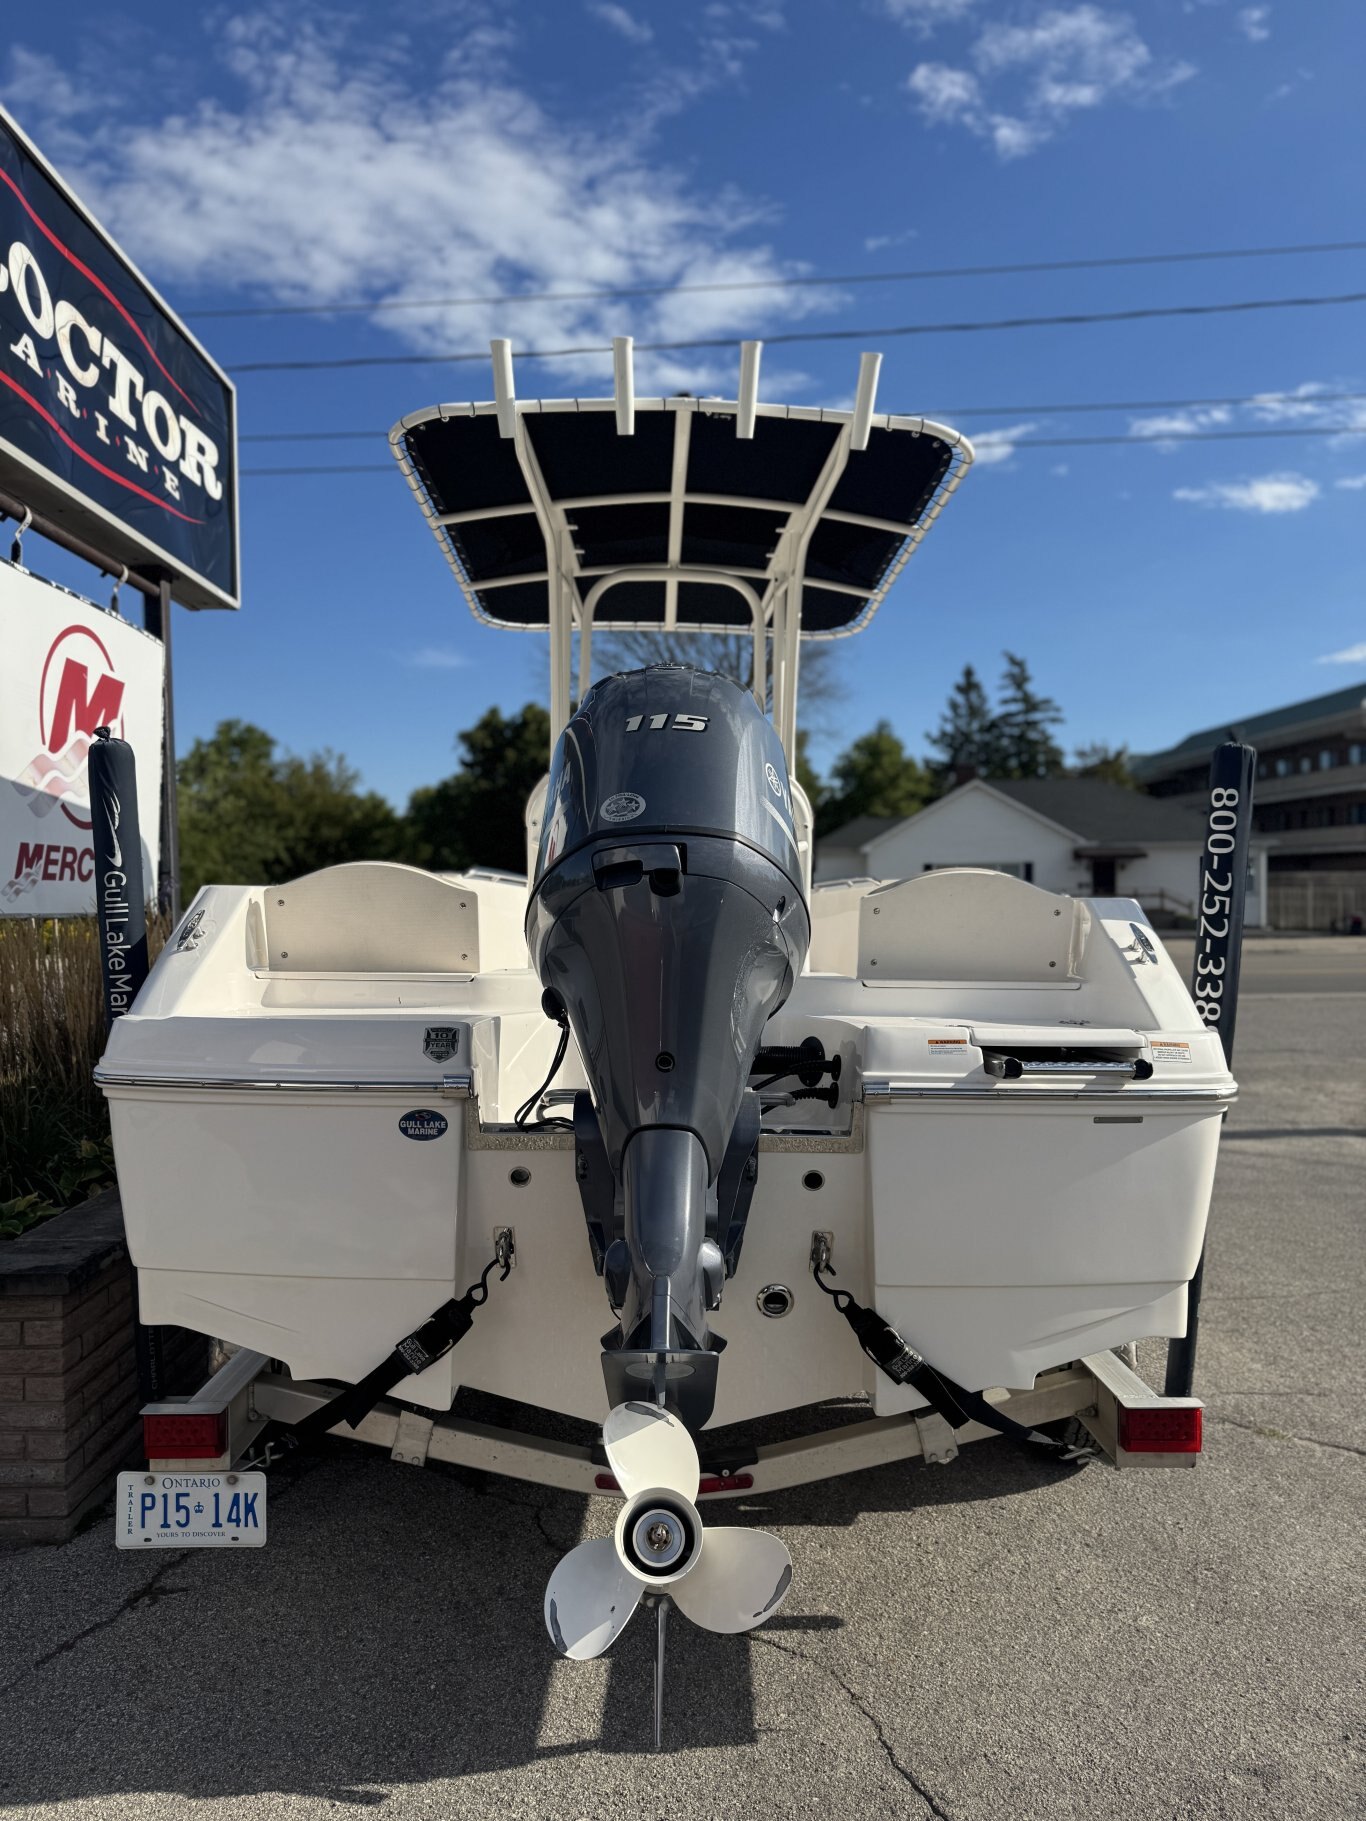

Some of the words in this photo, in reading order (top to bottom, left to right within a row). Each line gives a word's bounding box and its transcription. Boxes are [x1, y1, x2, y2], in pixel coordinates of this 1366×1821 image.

[0, 241, 222, 501] OCTOR
[9, 332, 181, 501] ARINE
[625, 713, 709, 732] 115
[14, 841, 95, 883] MERC
[104, 870, 129, 913] Gull
[1195, 787, 1239, 1033] 800-252-338
[105, 917, 132, 971] Lake
[109, 973, 133, 1020] Mar
[433, 1031, 449, 1039] 10
[400, 1120, 422, 1128] GULL
[424, 1120, 447, 1129] LAKE
[407, 1127, 439, 1136] MARINE
[162, 1477, 221, 1489] ONTARIO
[140, 1492, 191, 1528] P15
[211, 1492, 259, 1528] 14K
